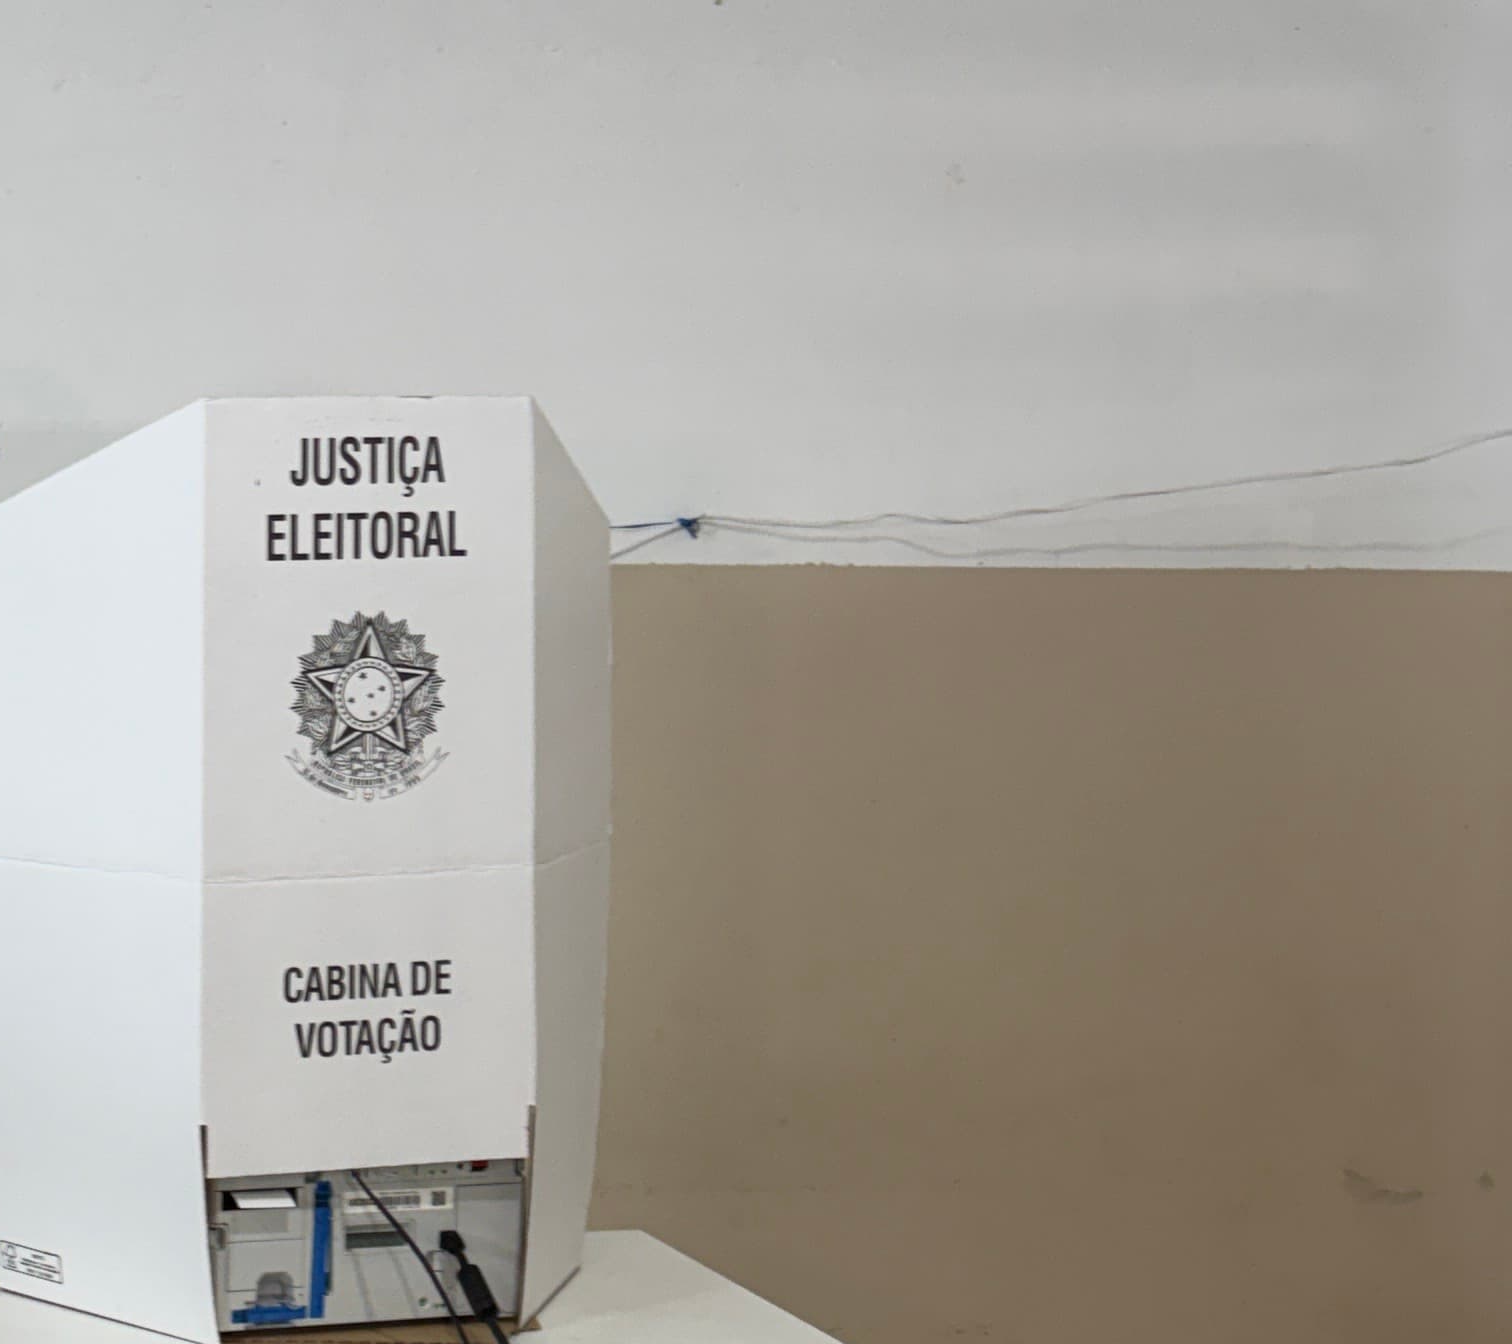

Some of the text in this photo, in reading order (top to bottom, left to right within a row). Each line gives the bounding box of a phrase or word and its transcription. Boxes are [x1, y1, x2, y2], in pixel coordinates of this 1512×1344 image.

[289, 435, 446, 498] JUSTIÇA
[266, 510, 468, 562] ELEITORAL
[283, 959, 452, 1004] CABINA DE
[294, 1008, 442, 1064] VOTAÇÃO
